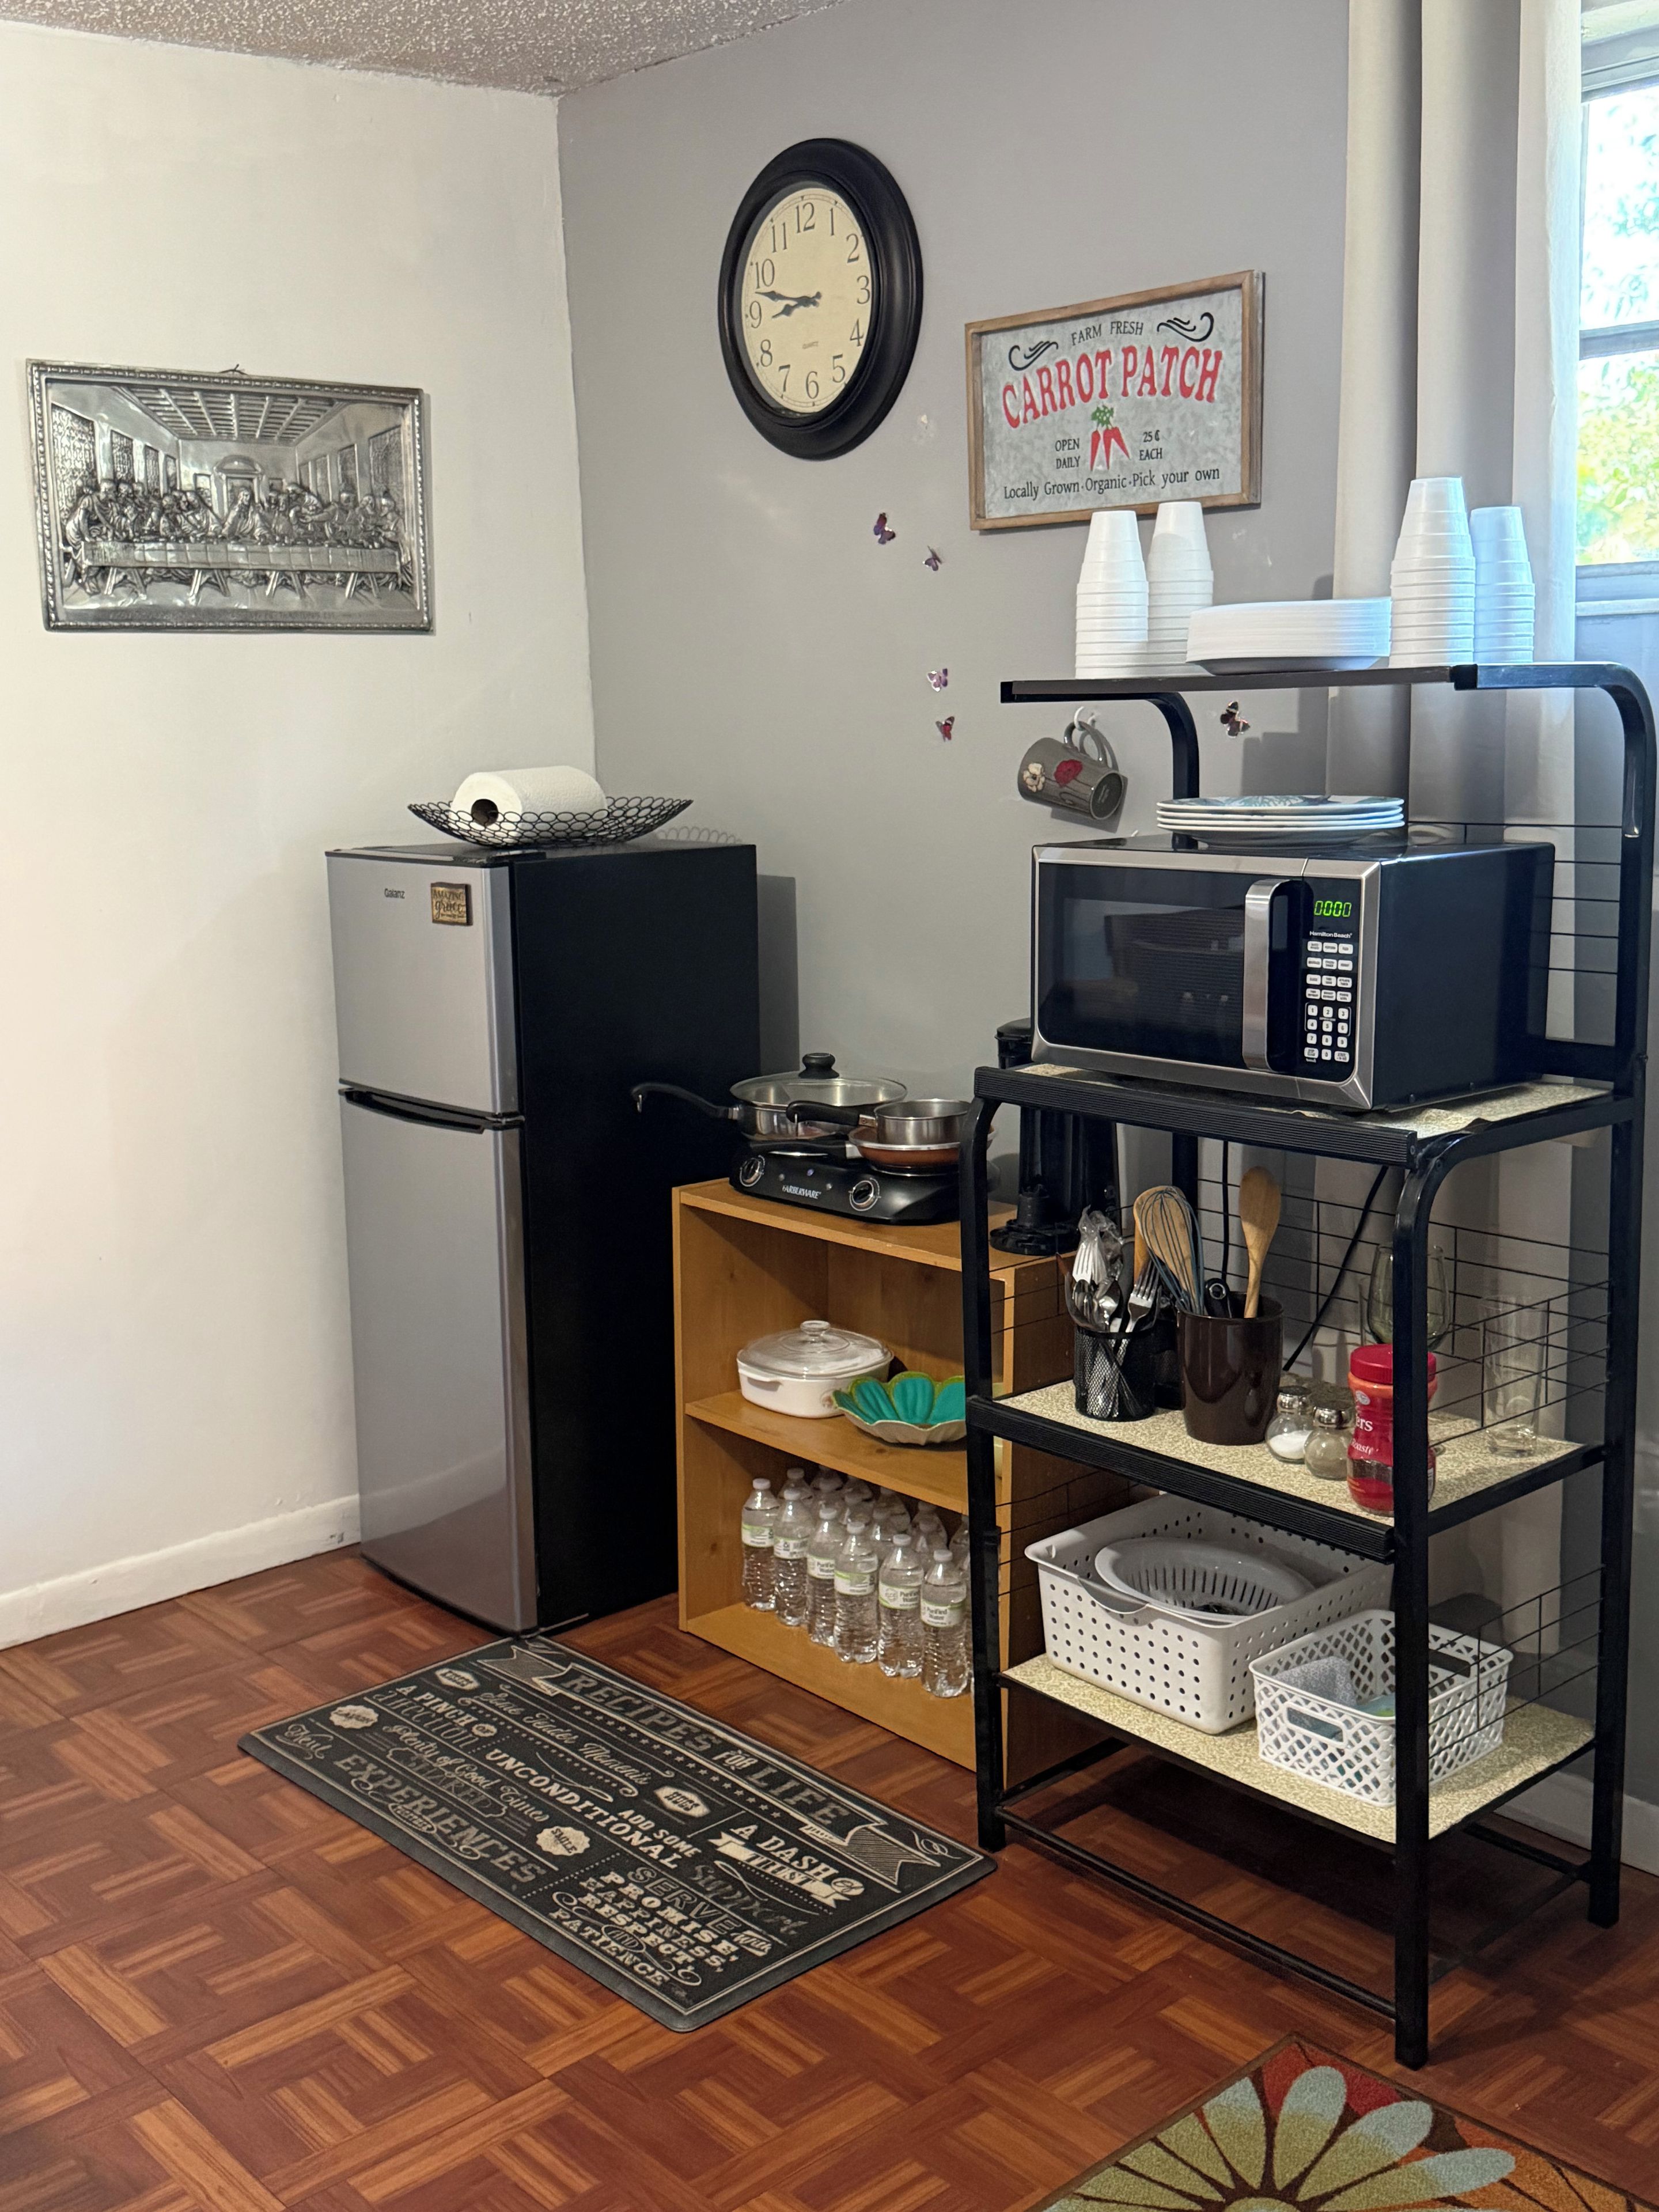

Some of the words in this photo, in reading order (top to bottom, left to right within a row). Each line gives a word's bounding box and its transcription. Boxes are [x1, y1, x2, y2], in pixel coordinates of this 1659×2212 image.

[796, 202, 816, 233] 12
[830, 207, 835, 236] 1
[772, 222, 787, 253] 11
[847, 233, 860, 263] 2
[755, 259, 775, 289] 10
[857, 275, 870, 304] 3
[749, 301, 762, 328] 9
[850, 319, 864, 347] 4
[1071, 324, 1101, 346] FARM
[1110, 321, 1143, 335] FRESH
[760, 340, 773, 367] 8
[832, 354, 846, 382] 5
[778, 364, 791, 393] 7
[806, 371, 820, 399] 6
[1002, 350, 1112, 429] CARROT
[1121, 345, 1222, 403] PATCH
[1055, 438, 1080, 452] OPEN
[1139, 448, 1162, 461] EACH
[1056, 456, 1081, 469] DAILY
[1004, 482, 1039, 501] Locally
[1044, 482, 1080, 495] Grown
[1085, 474, 1127, 495] Organic
[1132, 469, 1156, 487] Pick
[1161, 471, 1189, 489] your
[1195, 468, 1220, 481] own
[396, 1685, 418, 1696] A
[414, 1692, 478, 1726] PINCH
[522, 1712, 578, 1744] Tender
[578, 1743, 652, 1785] Moments
[560, 1675, 721, 1752] RECIPES
[712, 1748, 757, 1771] FOR
[747, 1765, 850, 1824] LIFE
[382, 1725, 440, 1758] Plenty
[435, 1756, 465, 1768] of
[455, 1763, 501, 1789] Good
[499, 1785, 550, 1823] Times
[484, 1748, 683, 1869] UNCONDITIONAL
[663, 1791, 700, 1811] HUGS
[333, 1753, 547, 1883] EXPERIENCES
[618, 1809, 655, 1830] ADD
[653, 1828, 701, 1857] SOME
[551, 1827, 578, 1854] SMILE
[729, 1824, 758, 1840] A
[756, 1835, 839, 1882] DASH
[744, 1853, 816, 1888] TRUST
[579, 1877, 724, 1972] HAPPINESS,
[600, 1871, 739, 1961] PROMISE,
[627, 1866, 742, 1935] SERVE
[730, 1931, 772, 1954] With
[549, 1908, 671, 1986] PATIENCE
[578, 1893, 695, 1972] RESPECT,
[609, 1928, 637, 1949] AND
